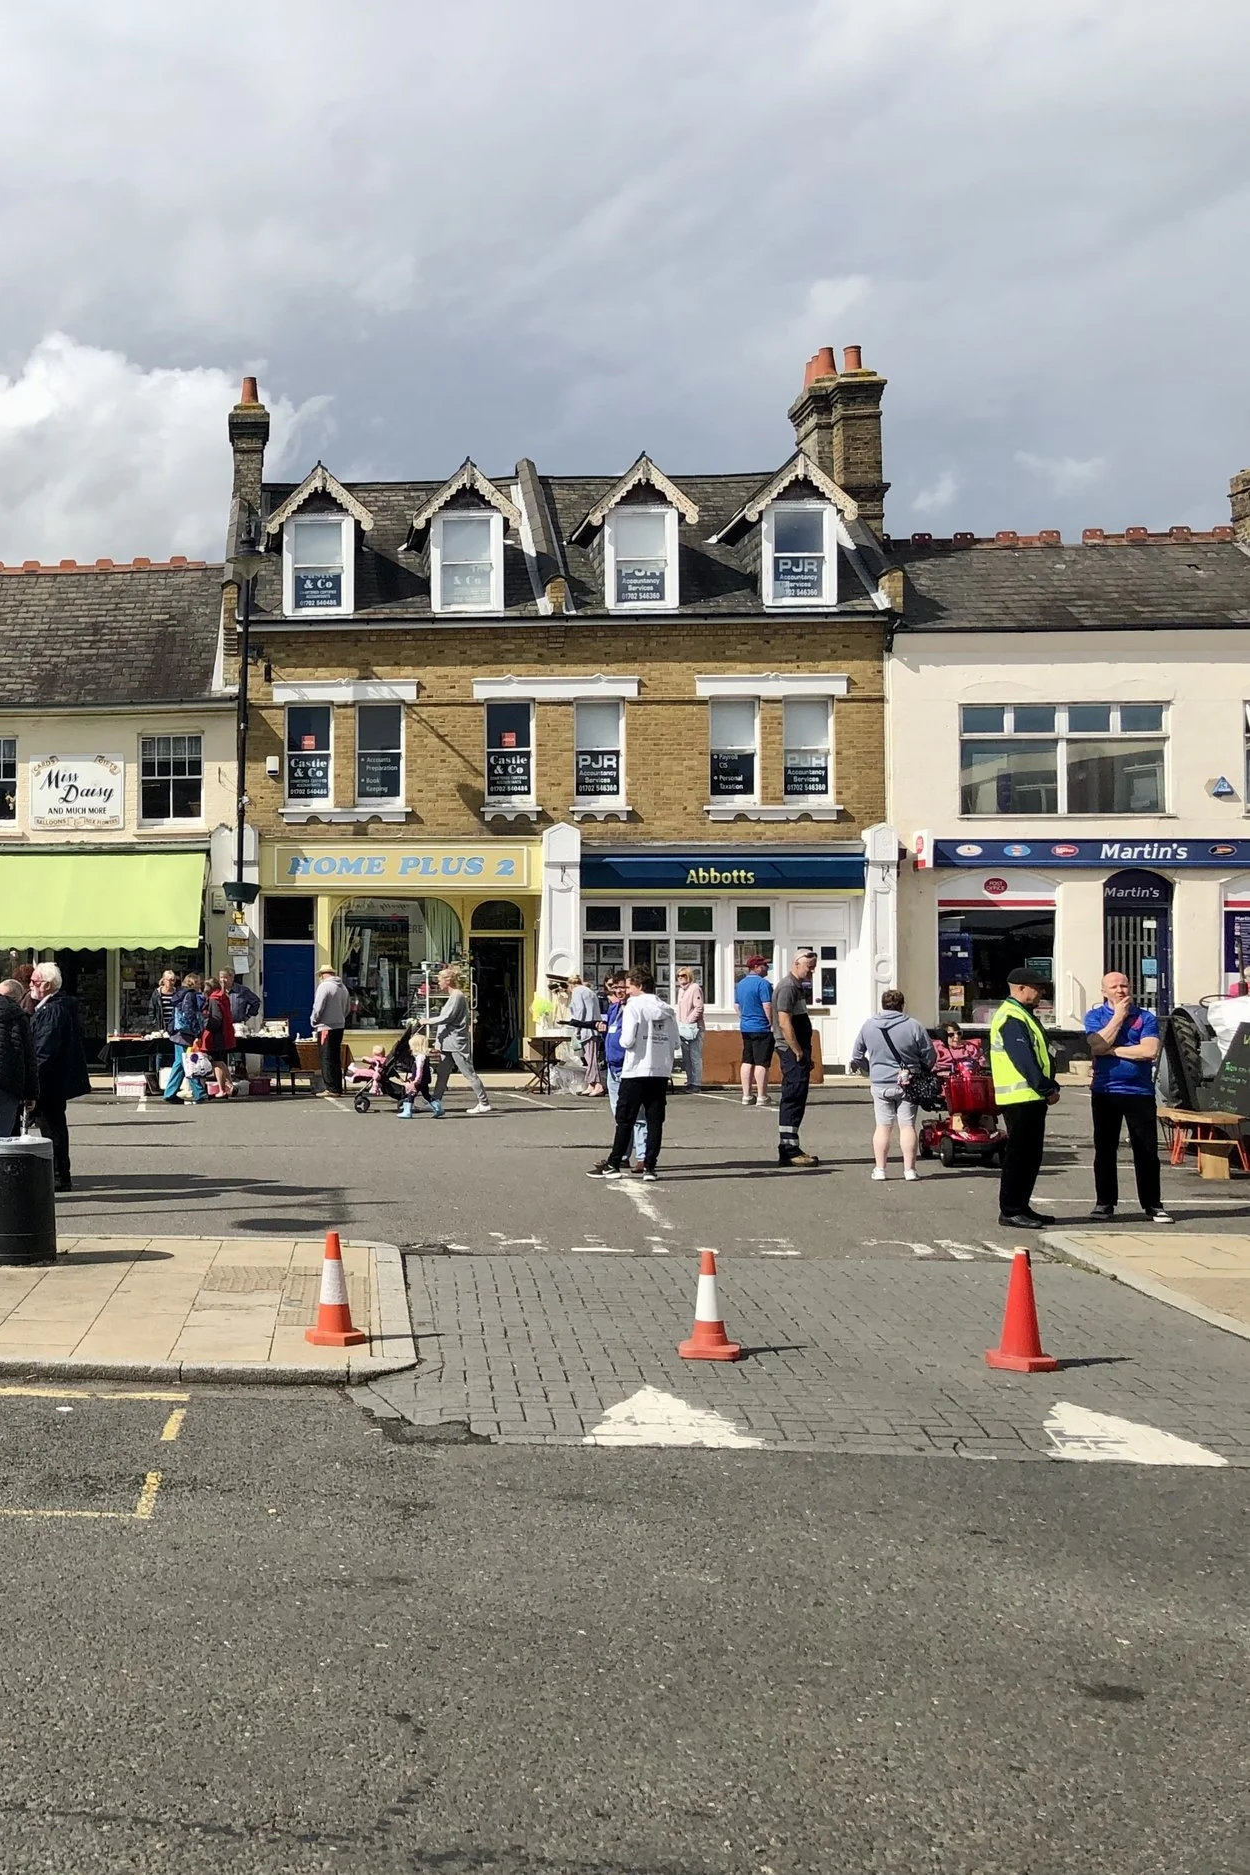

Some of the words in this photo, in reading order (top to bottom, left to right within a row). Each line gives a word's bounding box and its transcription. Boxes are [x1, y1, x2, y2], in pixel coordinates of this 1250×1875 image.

[779, 559, 817, 572] PJR
[304, 579, 313, 588] &
[317, 579, 333, 588] Co
[621, 592, 638, 600] 01702
[33, 759, 57, 772] CARDS
[97, 758, 118, 771] GIFTS
[290, 758, 328, 768] Castle
[490, 755, 528, 765] Castle
[578, 754, 617, 768] PJR
[786, 753, 826, 767] PJR
[294, 768, 304, 777] &
[307, 768, 324, 777] Co
[494, 765, 504, 774] &
[507, 765, 524, 774] Co
[39, 769, 79, 790] Miss
[58, 784, 114, 804] Daisy
[578, 784, 594, 792] 01702
[48, 807, 64, 815] AND
[36, 818, 67, 826] BALLOONS
[1100, 843, 1188, 859] Martin's
[286, 856, 387, 876] HOME
[397, 856, 485, 876] PLUS
[495, 858, 515, 877] 2
[686, 867, 755, 884] Abbotts
[1104, 886, 1160, 897] Martin's
